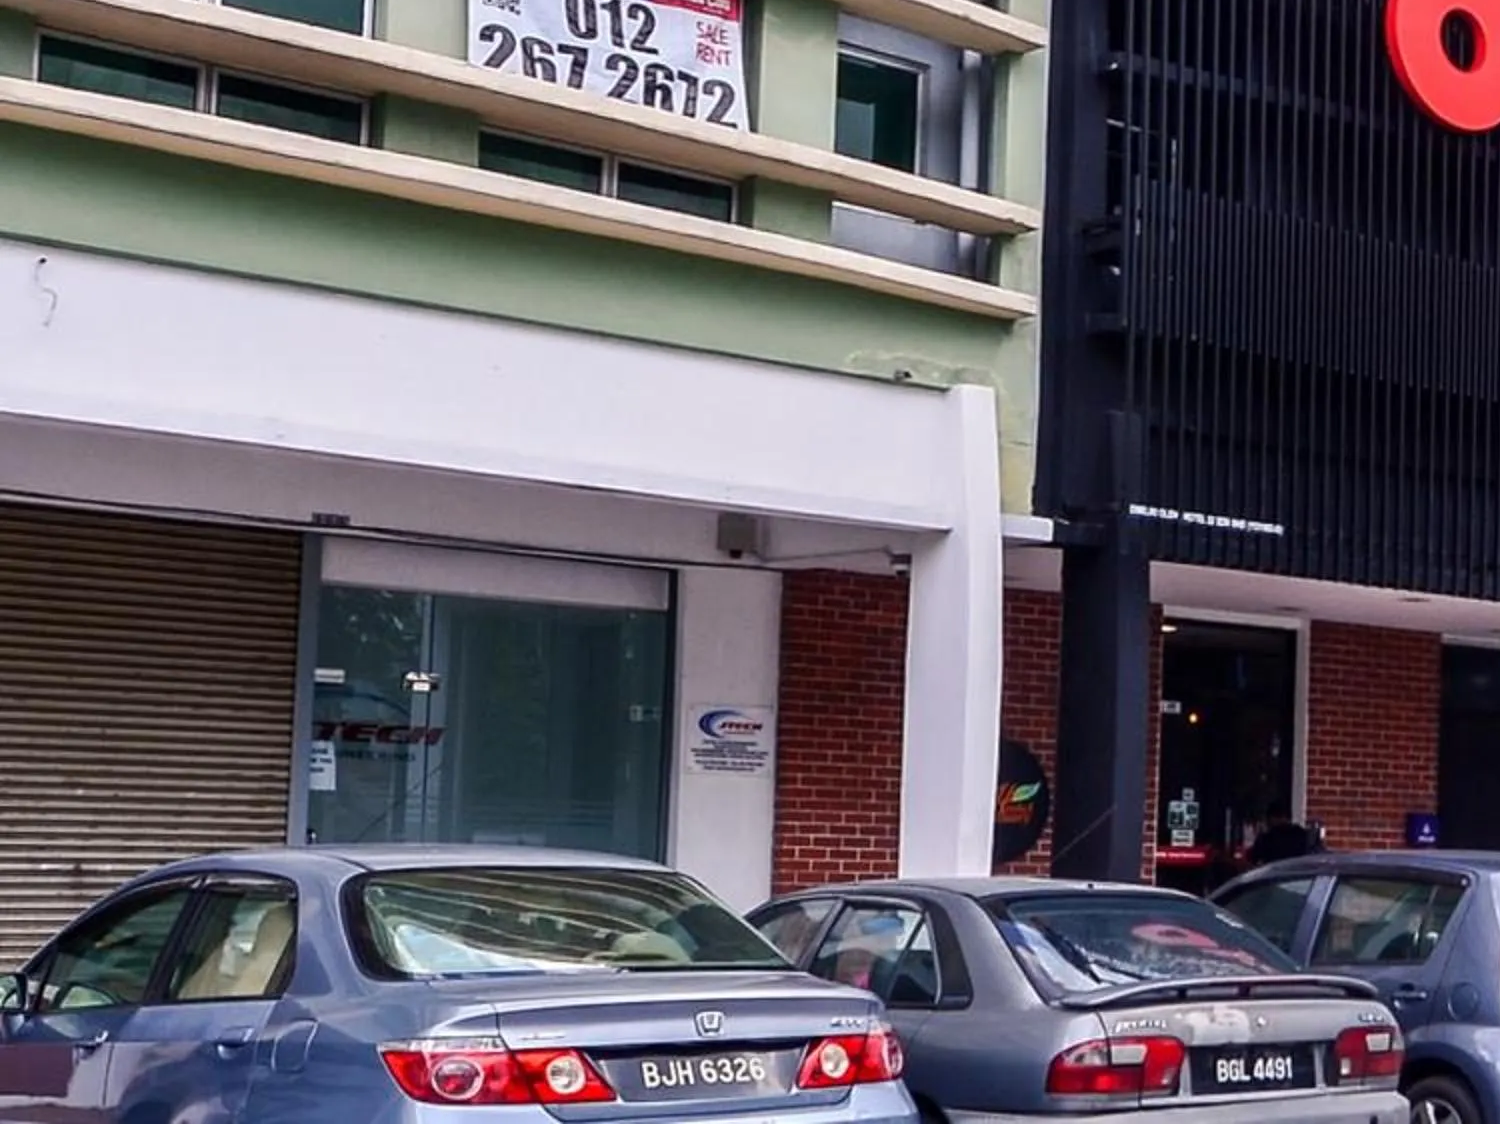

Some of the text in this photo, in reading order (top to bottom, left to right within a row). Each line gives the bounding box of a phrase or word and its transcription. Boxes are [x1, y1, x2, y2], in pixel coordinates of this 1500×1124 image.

[479, 24, 738, 129] 267 2672
[642, 1057, 765, 1089] BJH 6326
[1216, 1056, 1293, 1083] BGL 4491
